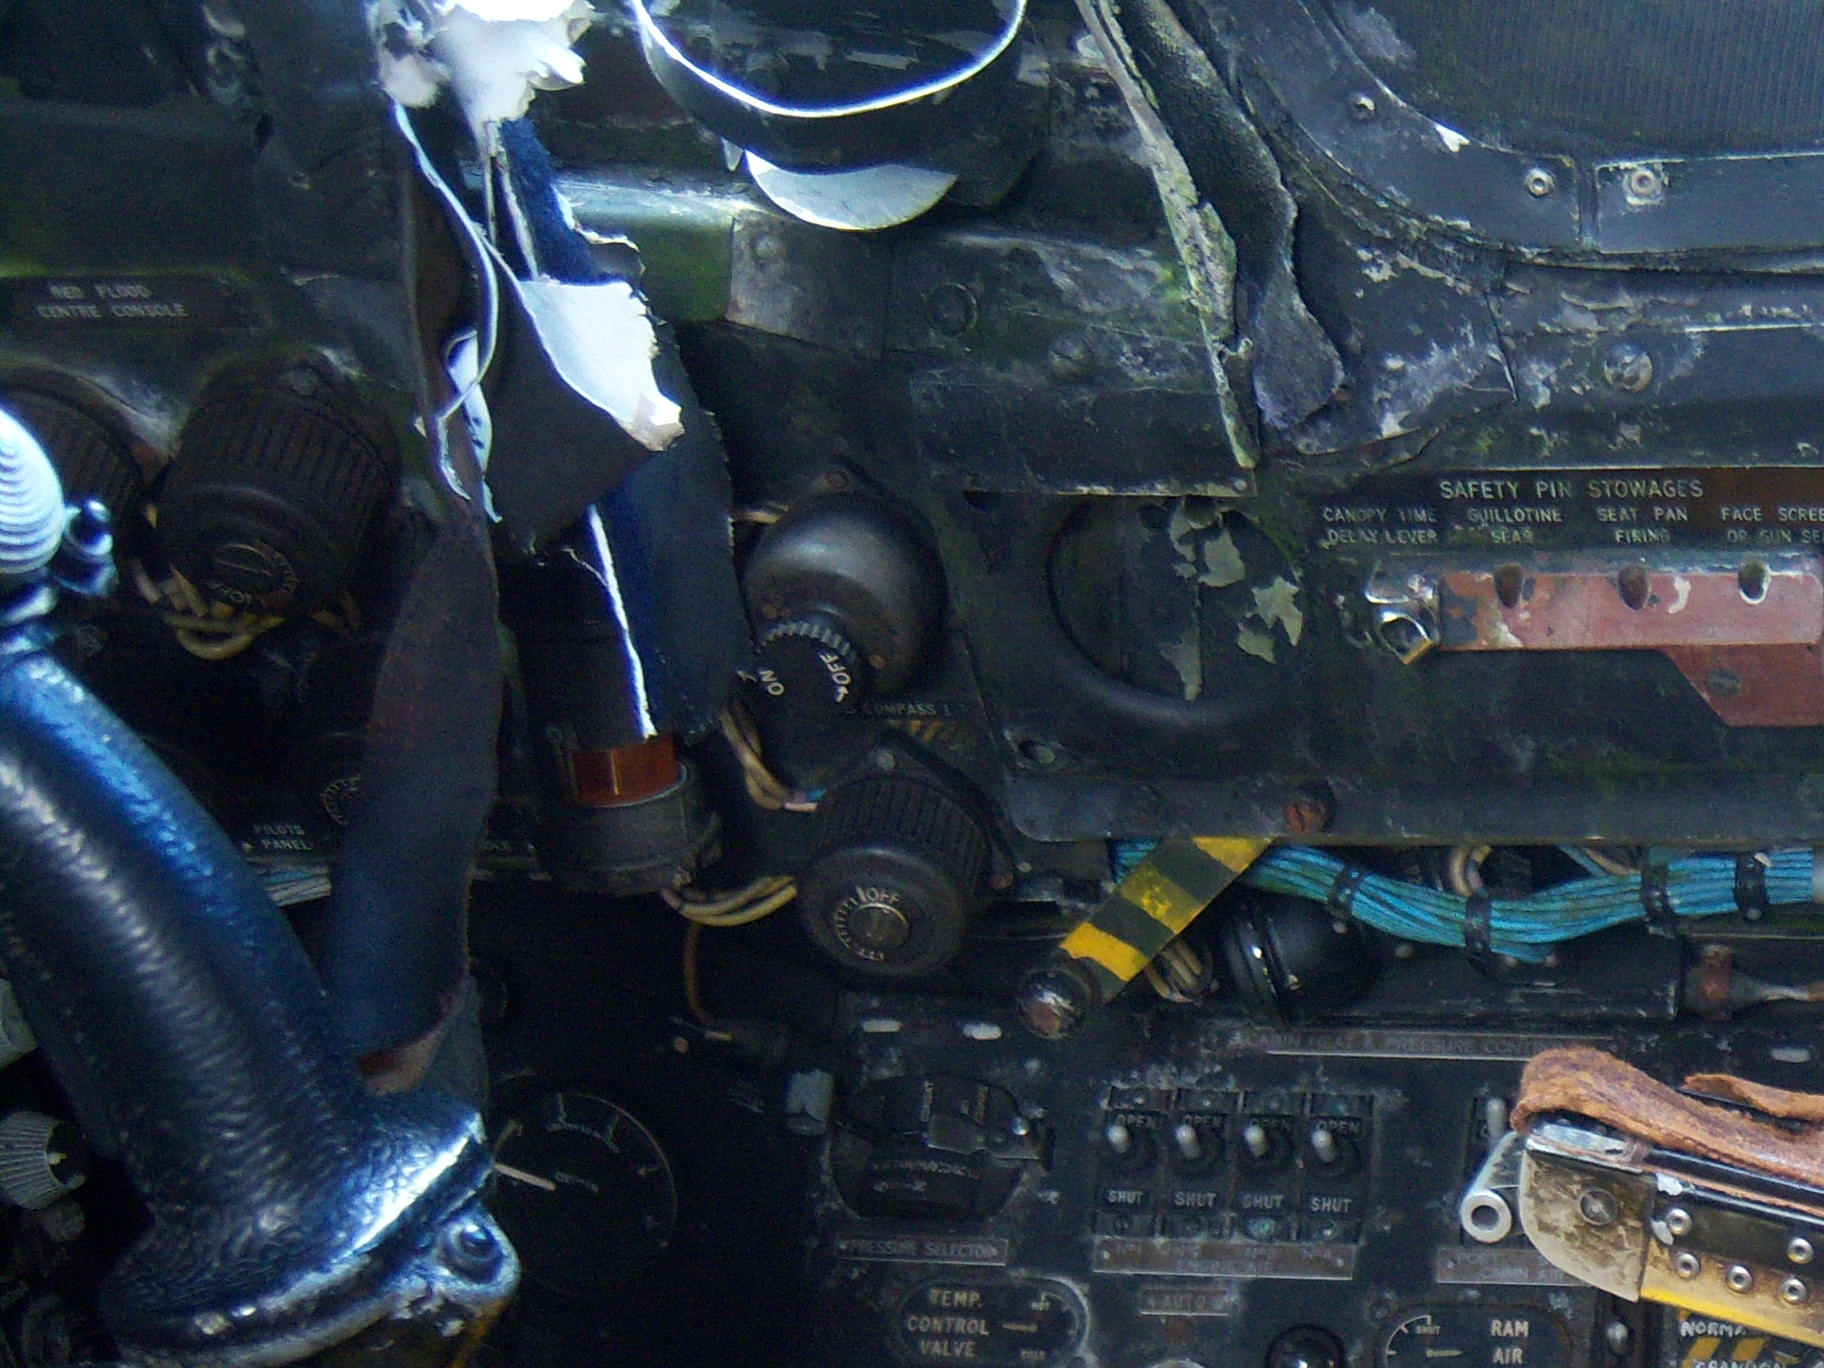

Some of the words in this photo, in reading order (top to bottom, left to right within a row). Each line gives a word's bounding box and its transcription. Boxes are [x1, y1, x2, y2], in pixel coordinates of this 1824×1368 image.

[111, 302, 188, 317] CONSOLE
[1439, 480, 1520, 499] SAFETY
[1535, 480, 1573, 499] PIN
[1588, 479, 1705, 499] STOWAGES
[1467, 507, 1563, 523] GUILLOTINE
[1597, 507, 1639, 522] SEAT
[1654, 507, 1689, 522] PAN
[1721, 507, 1764, 522] FACE
[1614, 529, 1671, 544] FIRING
[817, 651, 853, 687] OFF
[757, 667, 786, 697] ON
[1183, 1114, 1225, 1129] OPEN
[1316, 1120, 1360, 1135] OPEN
[1108, 1190, 1145, 1205] SHUT
[1174, 1191, 1217, 1208] SHUT
[1241, 1194, 1284, 1209] SHUT
[1310, 1196, 1352, 1213] SHUT
[905, 1313, 990, 1337] CONTROL
[1490, 1318, 1531, 1339] RAM
[919, 1338, 977, 1359] VALVE
[1491, 1346, 1525, 1366] AIR
